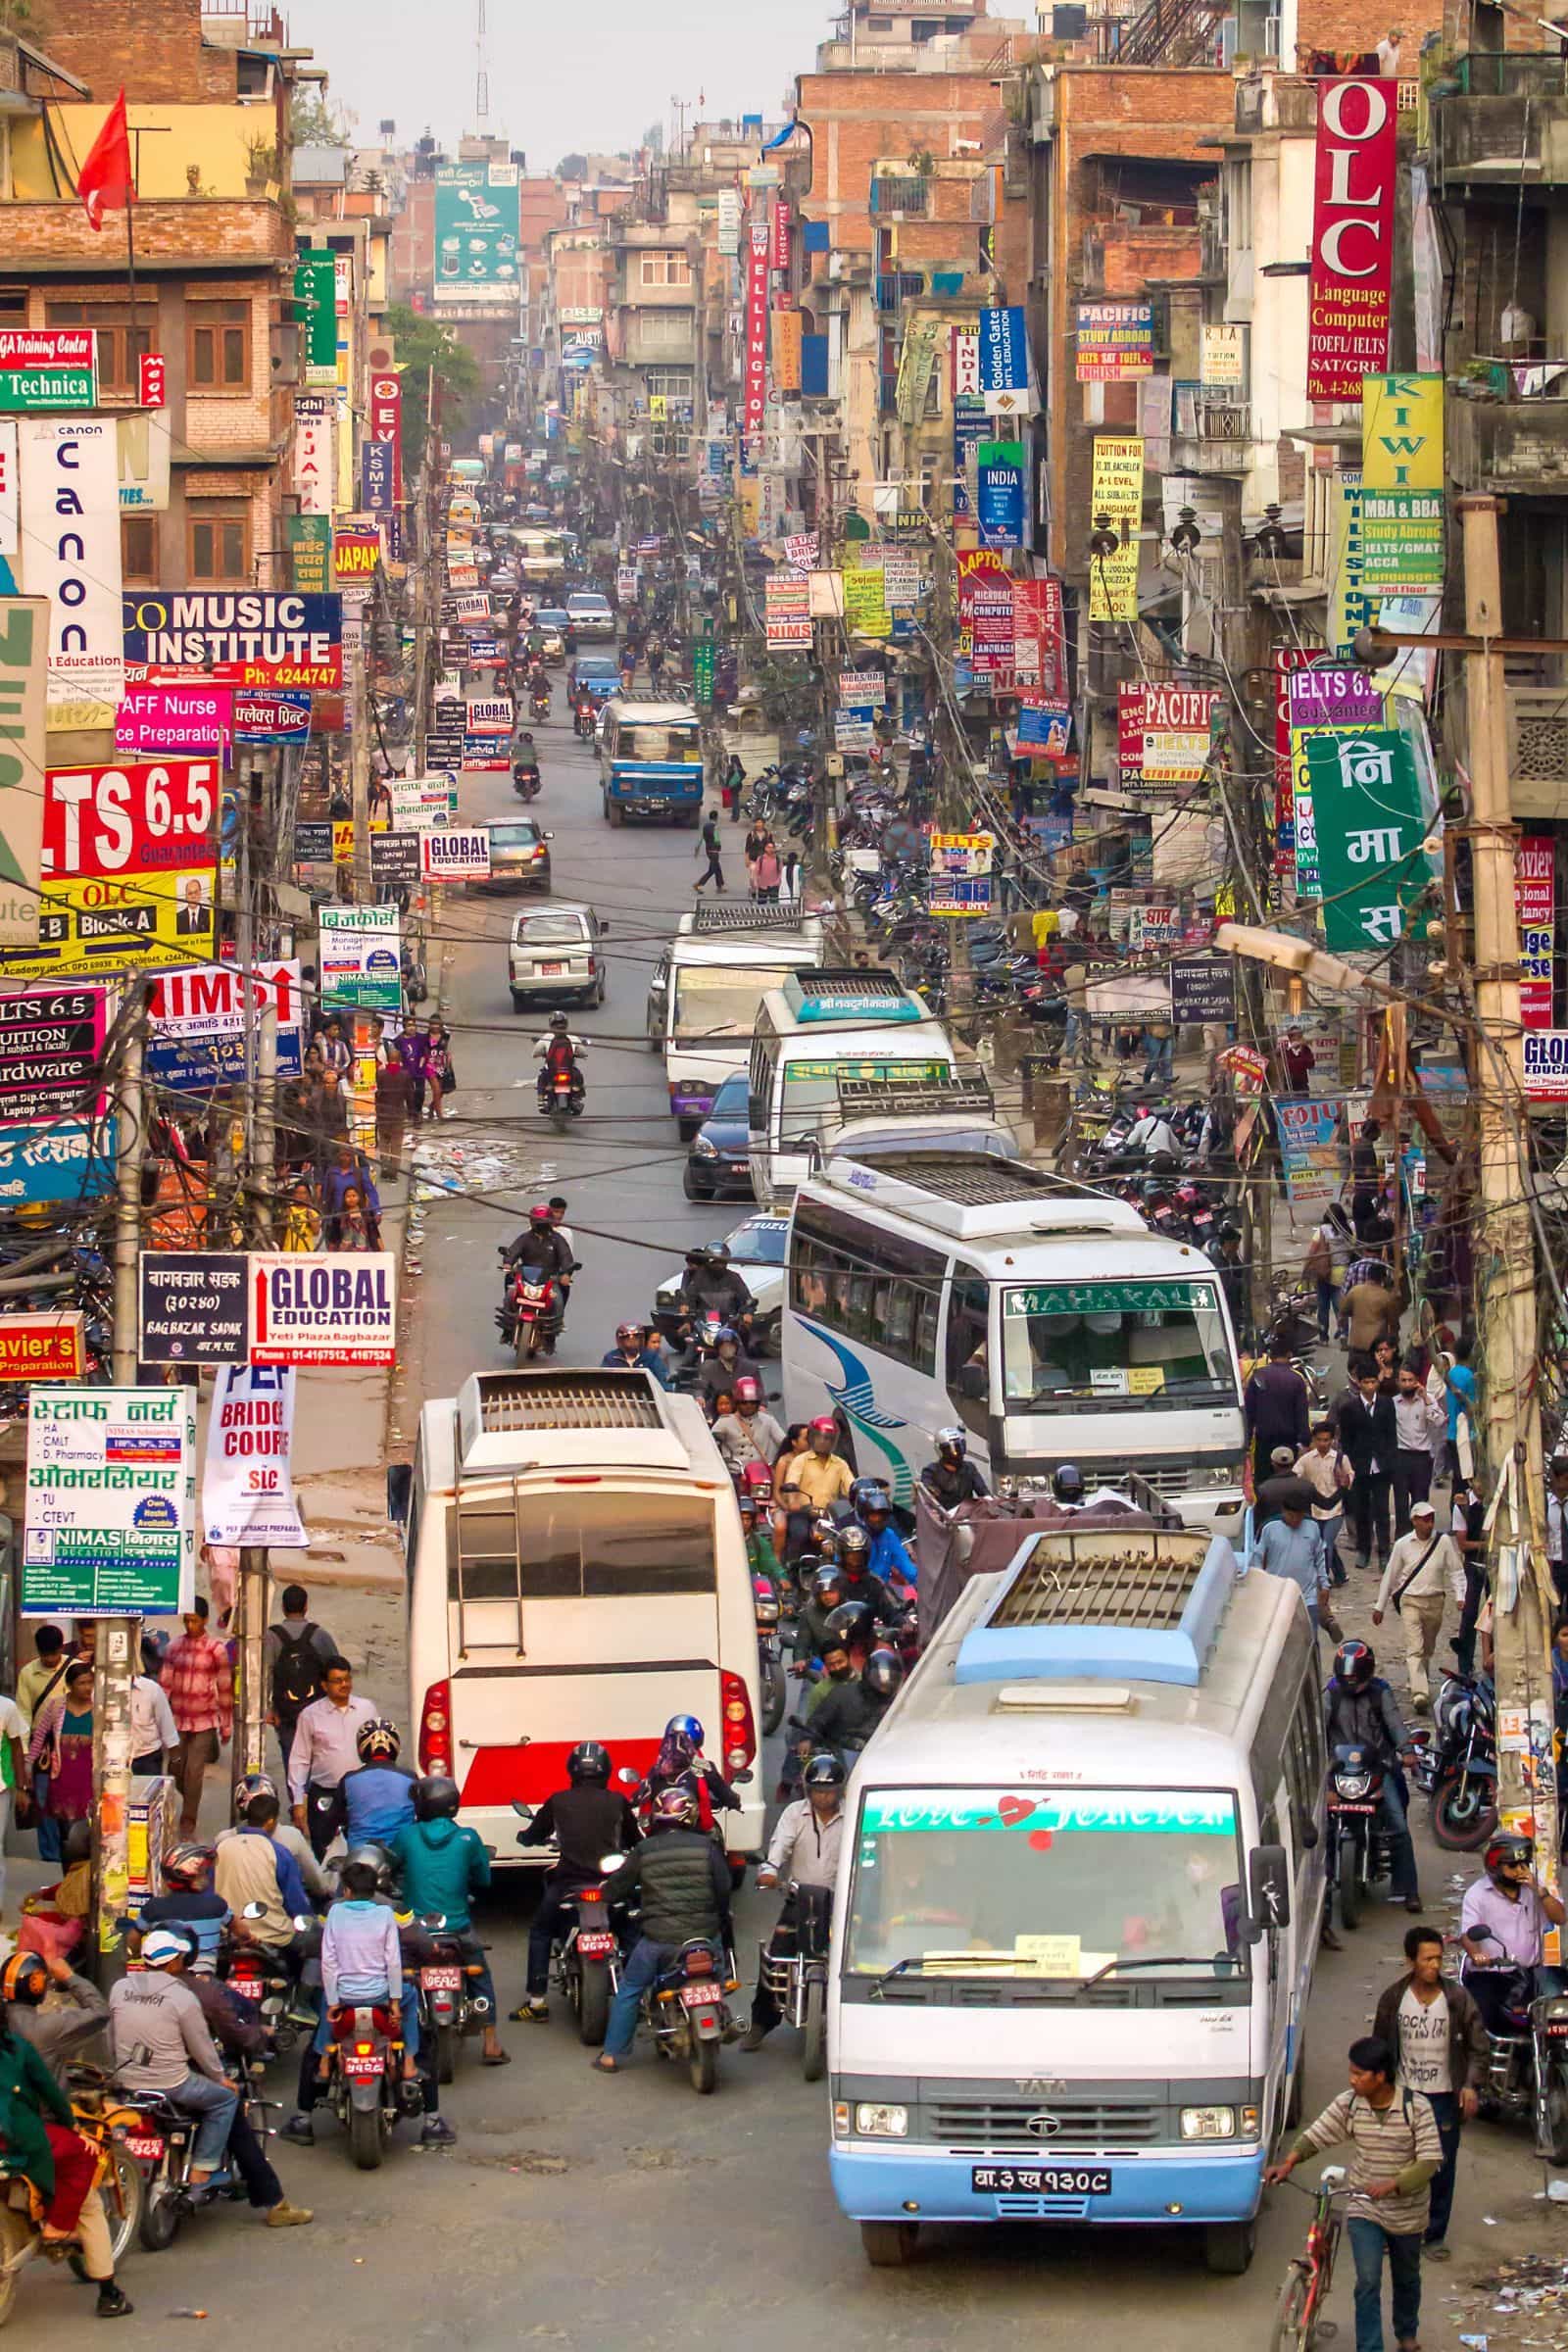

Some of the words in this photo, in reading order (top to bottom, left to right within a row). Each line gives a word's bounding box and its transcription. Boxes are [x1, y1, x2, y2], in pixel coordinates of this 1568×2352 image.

[1320, 81, 1387, 276] OLC
[1313, 281, 1387, 307] Language
[1079, 307, 1151, 321] PACIFIC
[1312, 308, 1388, 332] Computer
[17, 334, 55, 359] Training
[57, 334, 88, 354] Center
[1311, 359, 1380, 373] SAT/GRE
[9, 374, 88, 396] Technica
[1379, 377, 1428, 486] KIWI
[368, 447, 385, 494] KSMT
[987, 470, 1018, 485] INDIA
[1365, 499, 1396, 518] MBA
[1398, 504, 1408, 517] &
[1411, 498, 1441, 518] BBA
[336, 547, 380, 571] JAPAN
[1365, 543, 1441, 555] IELTS/GMAT
[1365, 558, 1399, 568] ACCA
[172, 596, 306, 629] MUSIC
[767, 625, 811, 639] NIMS
[148, 631, 330, 664] INSTITUTE
[56, 656, 122, 667] Education
[274, 667, 337, 685] 4244747
[1292, 671, 1347, 699] IELTS
[165, 696, 217, 714] Nurse
[474, 704, 511, 716] GLOBAL
[139, 724, 229, 748] Preparation
[1156, 735, 1208, 751] IELTS
[146, 765, 212, 837] 6.5
[431, 836, 488, 856] GLOBAL
[932, 835, 993, 848] IELTS
[83, 882, 137, 908] OLC
[50, 996, 86, 1016] 6.5
[271, 1267, 391, 1310] GLOBAL
[272, 1310, 391, 1326] EDUCATION
[33, 1399, 113, 1421] स्टाफ
[126, 1395, 178, 1421] नर्स
[56, 1449, 103, 1461] Pharmacy
[29, 1465, 179, 1491] ओभरसियर
[249, 1470, 278, 1491] SLC
[42, 1494, 55, 1505] TU
[42, 1512, 75, 1523] CTEVT
[55, 1530, 121, 1546] NIMAS
[1014, 2080, 1067, 2095] TATA
